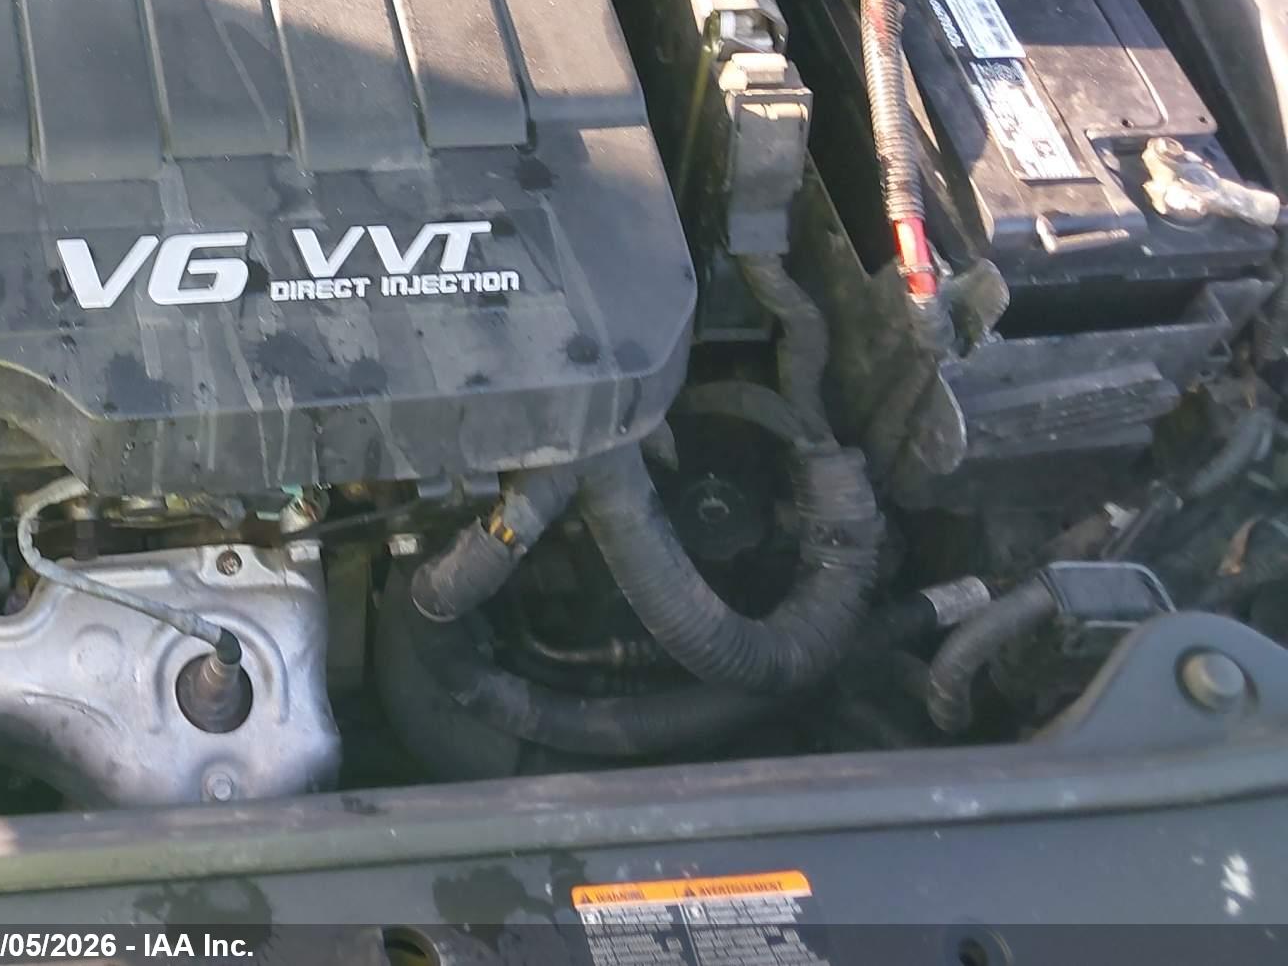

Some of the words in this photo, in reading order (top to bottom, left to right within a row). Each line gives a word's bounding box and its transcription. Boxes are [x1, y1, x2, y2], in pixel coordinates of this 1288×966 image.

[56, 232, 249, 310] V6
[292, 220, 492, 278] VVT
[270, 277, 372, 302] DIRECT
[380, 270, 520, 297] INJECTION
